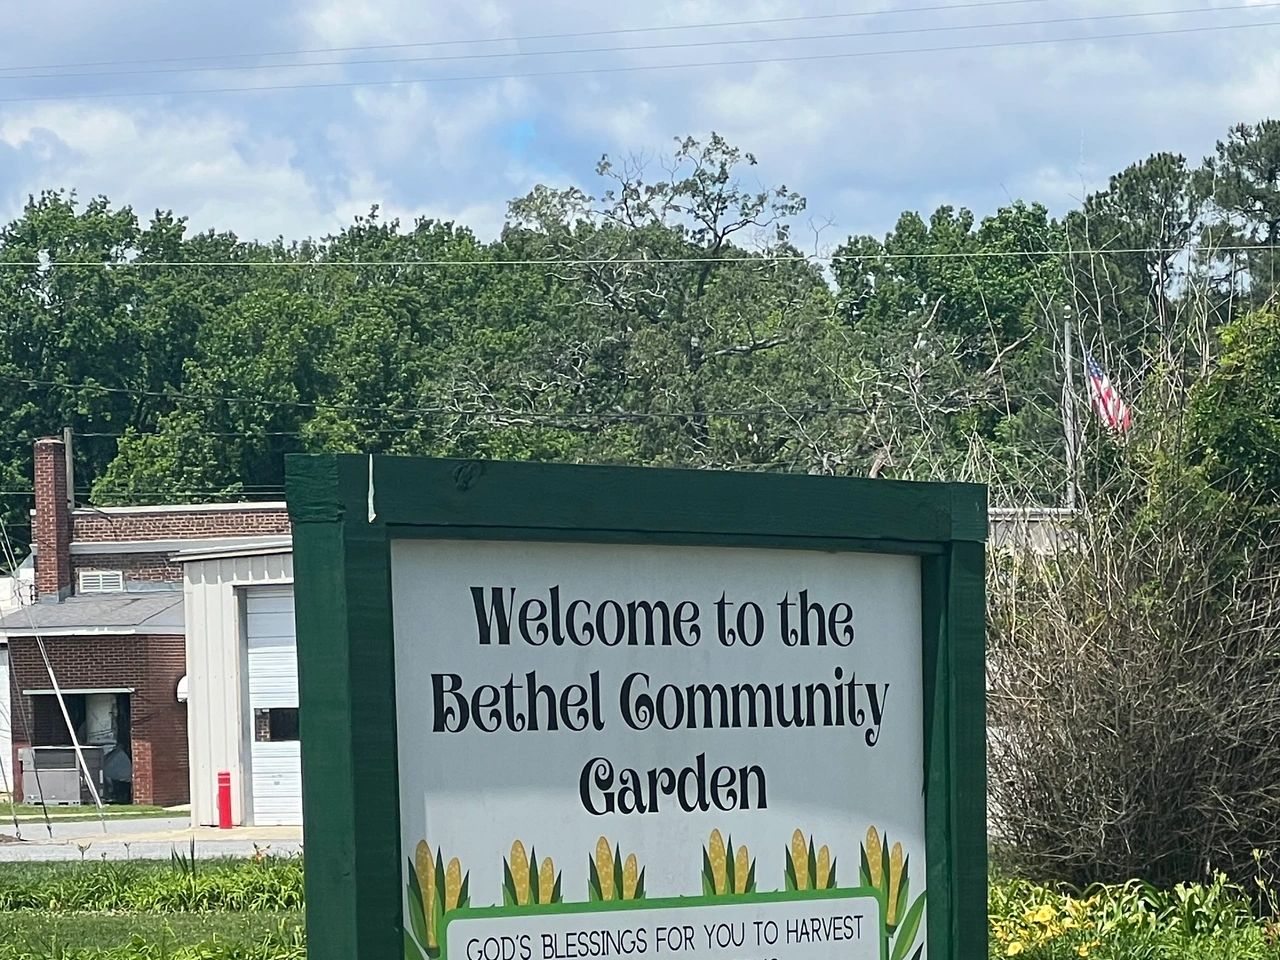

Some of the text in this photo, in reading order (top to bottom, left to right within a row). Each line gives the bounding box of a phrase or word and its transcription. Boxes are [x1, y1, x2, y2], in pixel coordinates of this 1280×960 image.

[469, 584, 855, 648] Welcome to the
[430, 666, 890, 748] Bethel Community
[579, 751, 768, 816] Garden
[540, 927, 648, 960] BLESSINGS
[656, 925, 695, 953] FOR
[703, 922, 745, 949] YOU
[752, 920, 779, 946] TO
[786, 914, 864, 944] HARVEST
